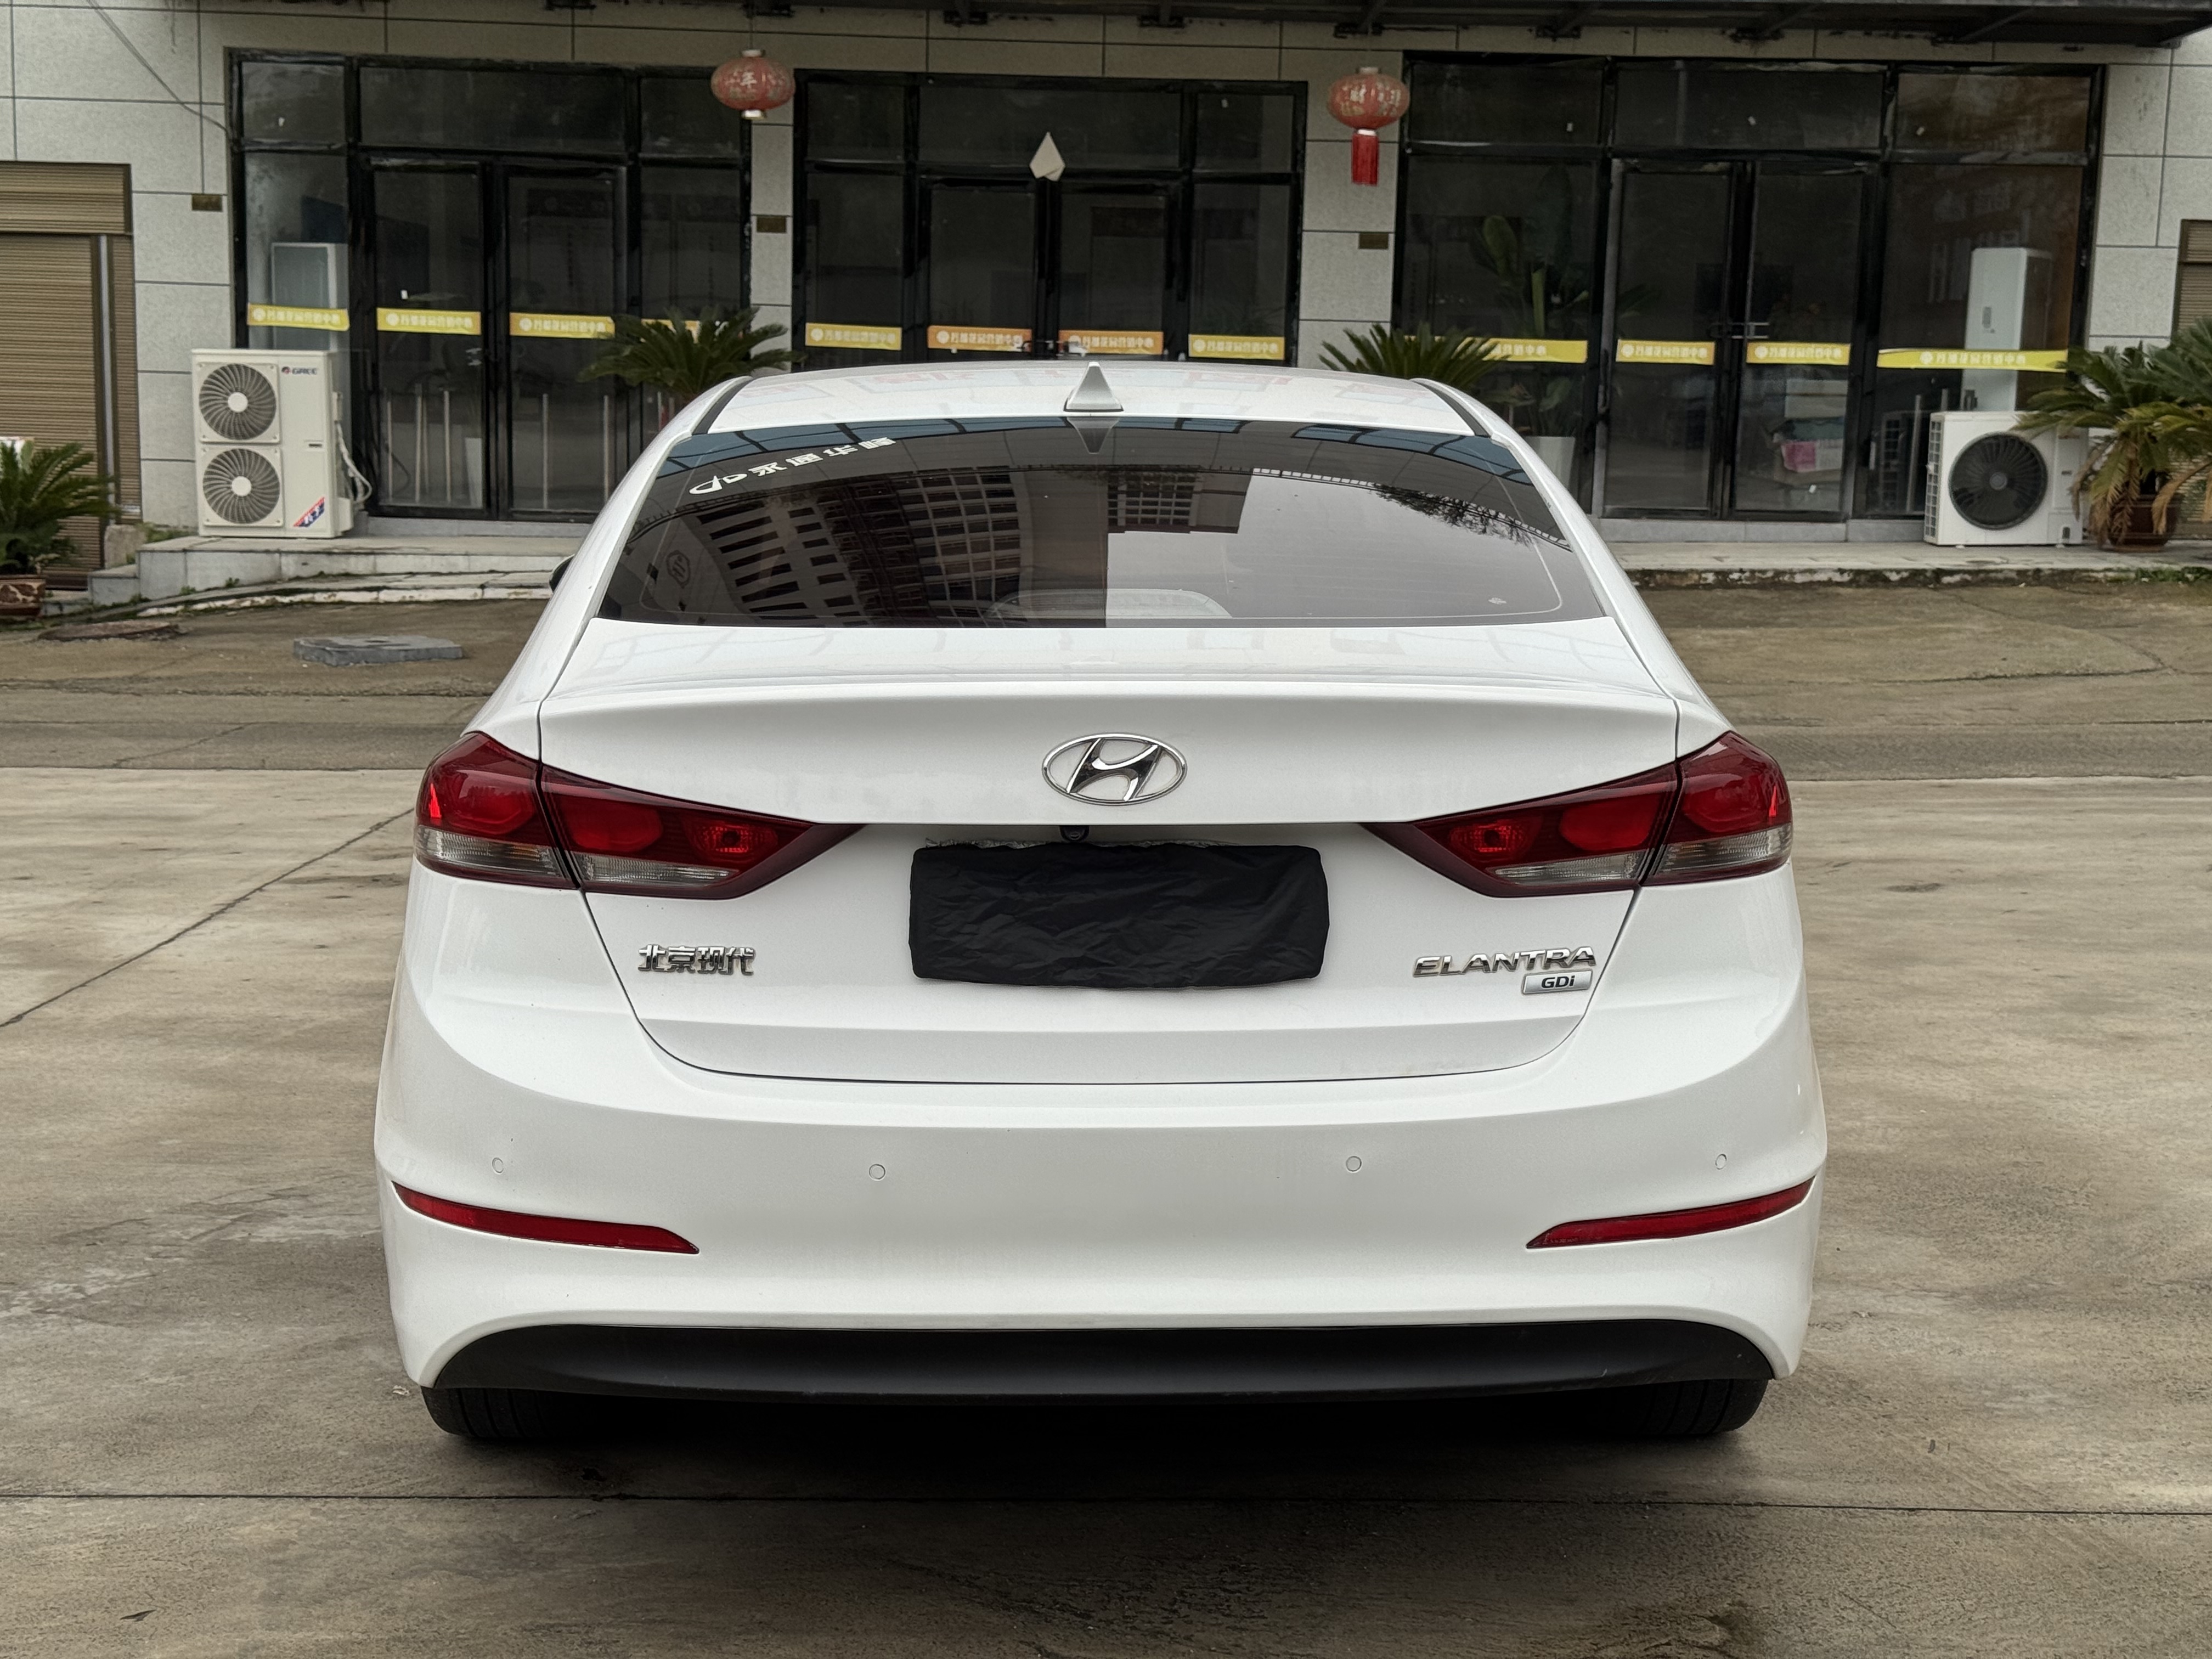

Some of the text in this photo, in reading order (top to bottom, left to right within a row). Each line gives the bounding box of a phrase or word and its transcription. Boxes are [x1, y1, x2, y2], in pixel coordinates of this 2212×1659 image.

[637, 944, 756, 976] 北京现代
[1413, 946, 1597, 978] ELANTRA
[1541, 975, 1576, 989] GDi
